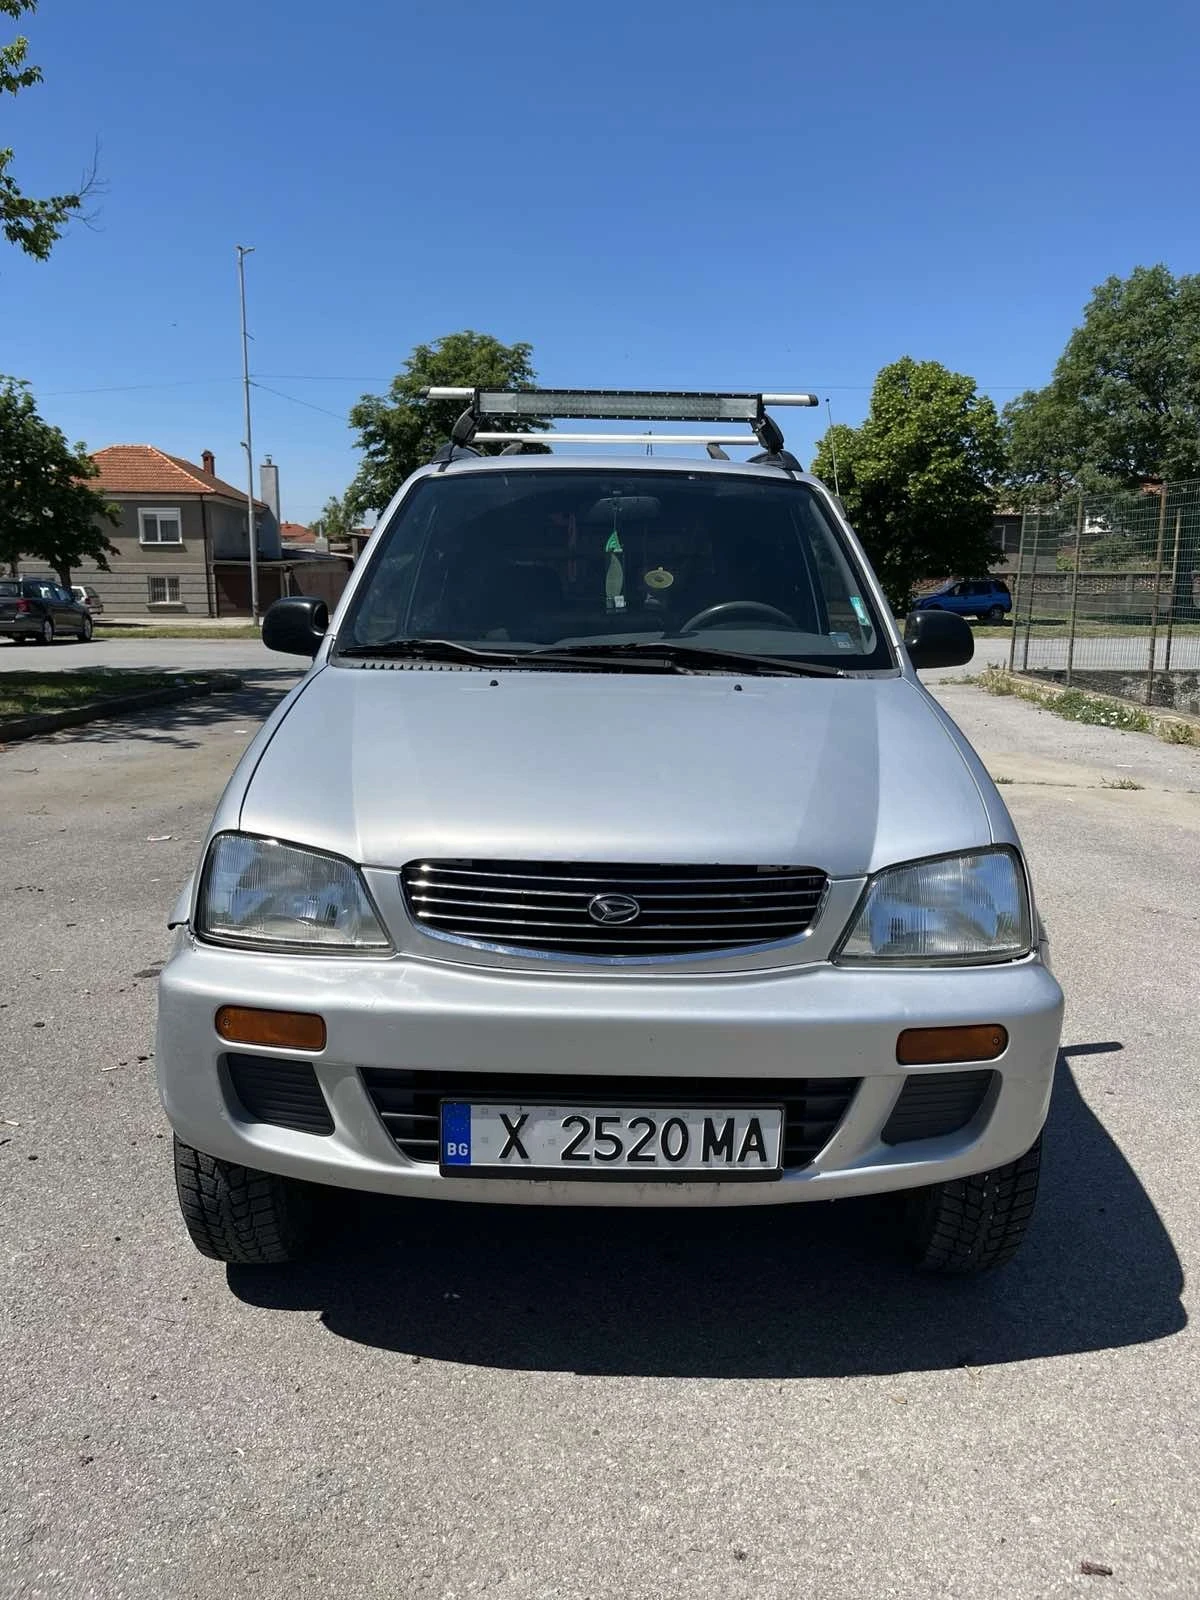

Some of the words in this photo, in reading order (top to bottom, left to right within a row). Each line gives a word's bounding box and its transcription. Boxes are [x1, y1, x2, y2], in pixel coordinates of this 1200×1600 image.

[447, 1143, 469, 1157] BG
[498, 1113, 530, 1160] X
[560, 1115, 689, 1163] 2520
[701, 1117, 768, 1163] MA
